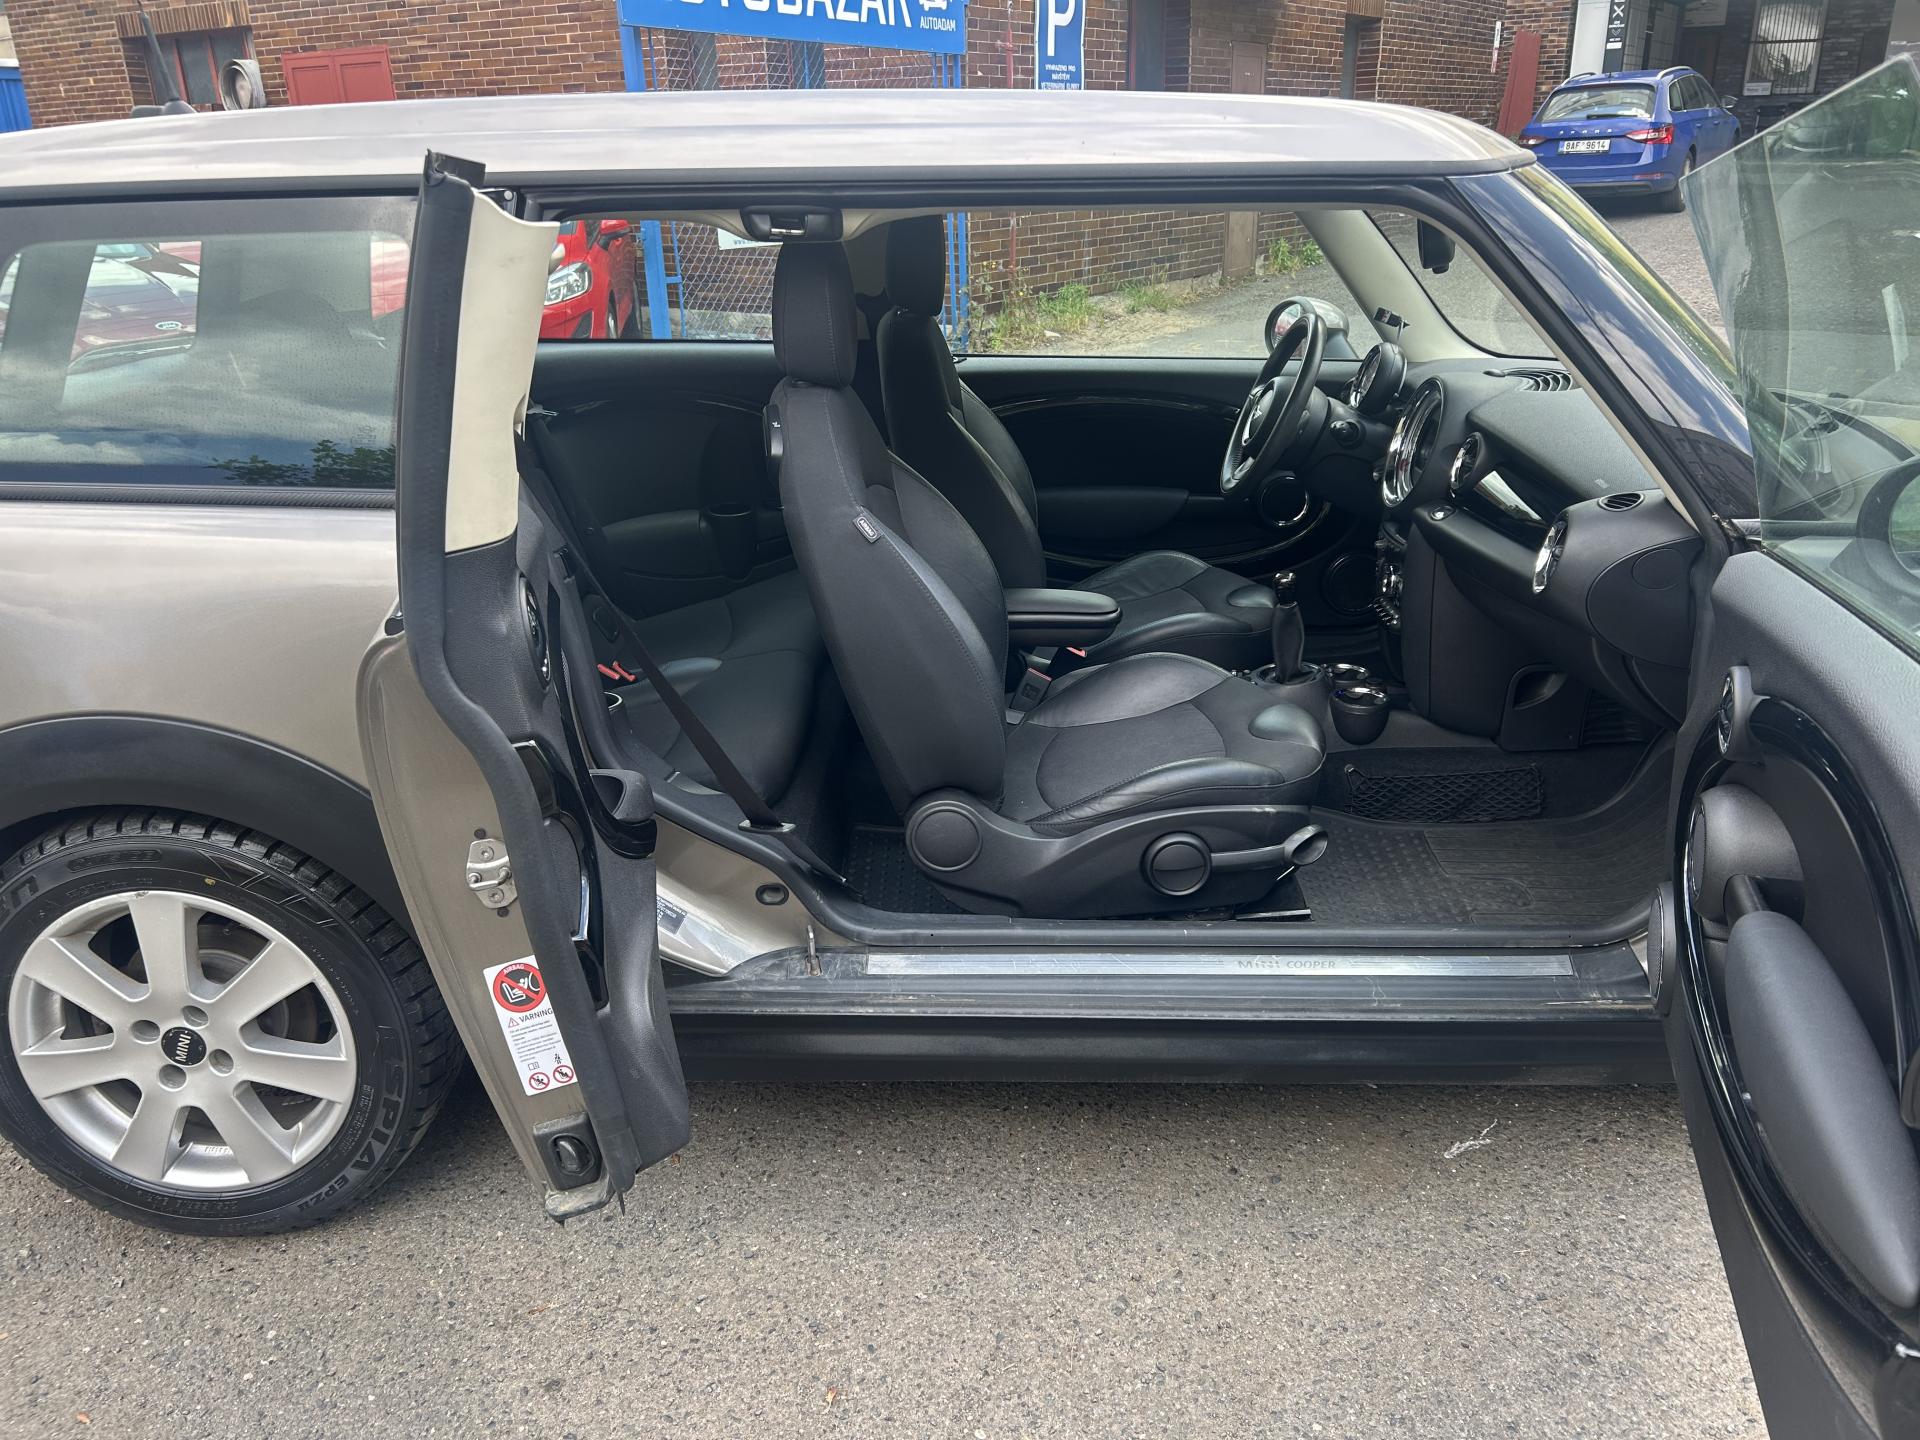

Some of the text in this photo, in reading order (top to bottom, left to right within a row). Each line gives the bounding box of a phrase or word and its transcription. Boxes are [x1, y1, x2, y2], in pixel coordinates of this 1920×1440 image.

[919, 16, 956, 32] AUTOADAM
[1047, 0, 1076, 57] P
[1565, 141, 1580, 150] 8AF
[503, 963, 525, 975] AIRBAG
[1286, 960, 1336, 969] COOPER
[519, 1007, 554, 1023] VARNING
[175, 1033, 192, 1062] MINI
